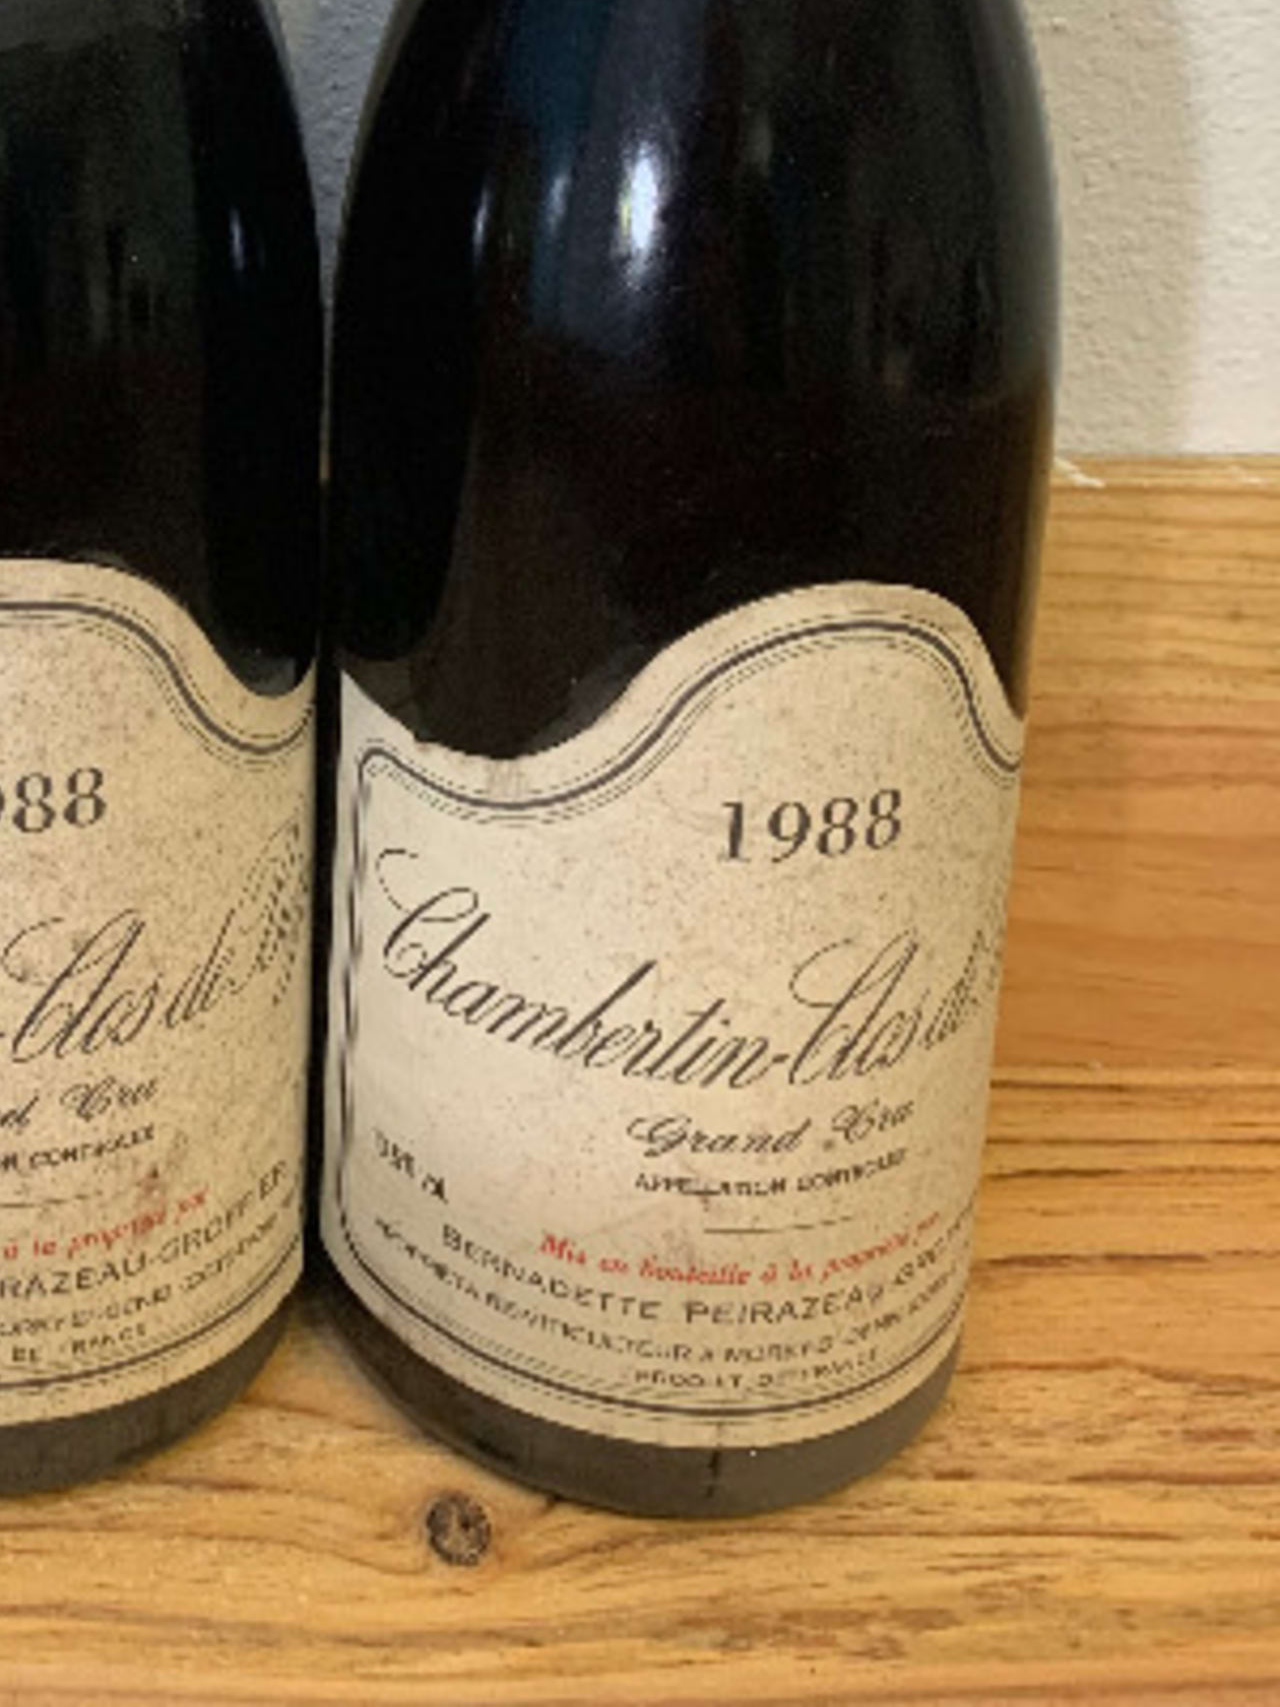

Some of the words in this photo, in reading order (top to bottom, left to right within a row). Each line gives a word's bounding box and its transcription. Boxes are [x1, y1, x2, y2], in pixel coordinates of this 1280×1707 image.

[720, 788, 903, 863] 1988
[59, 1074, 159, 1123] Cru
[625, 1115, 812, 1158] Grand
[830, 1097, 915, 1145] Cru
